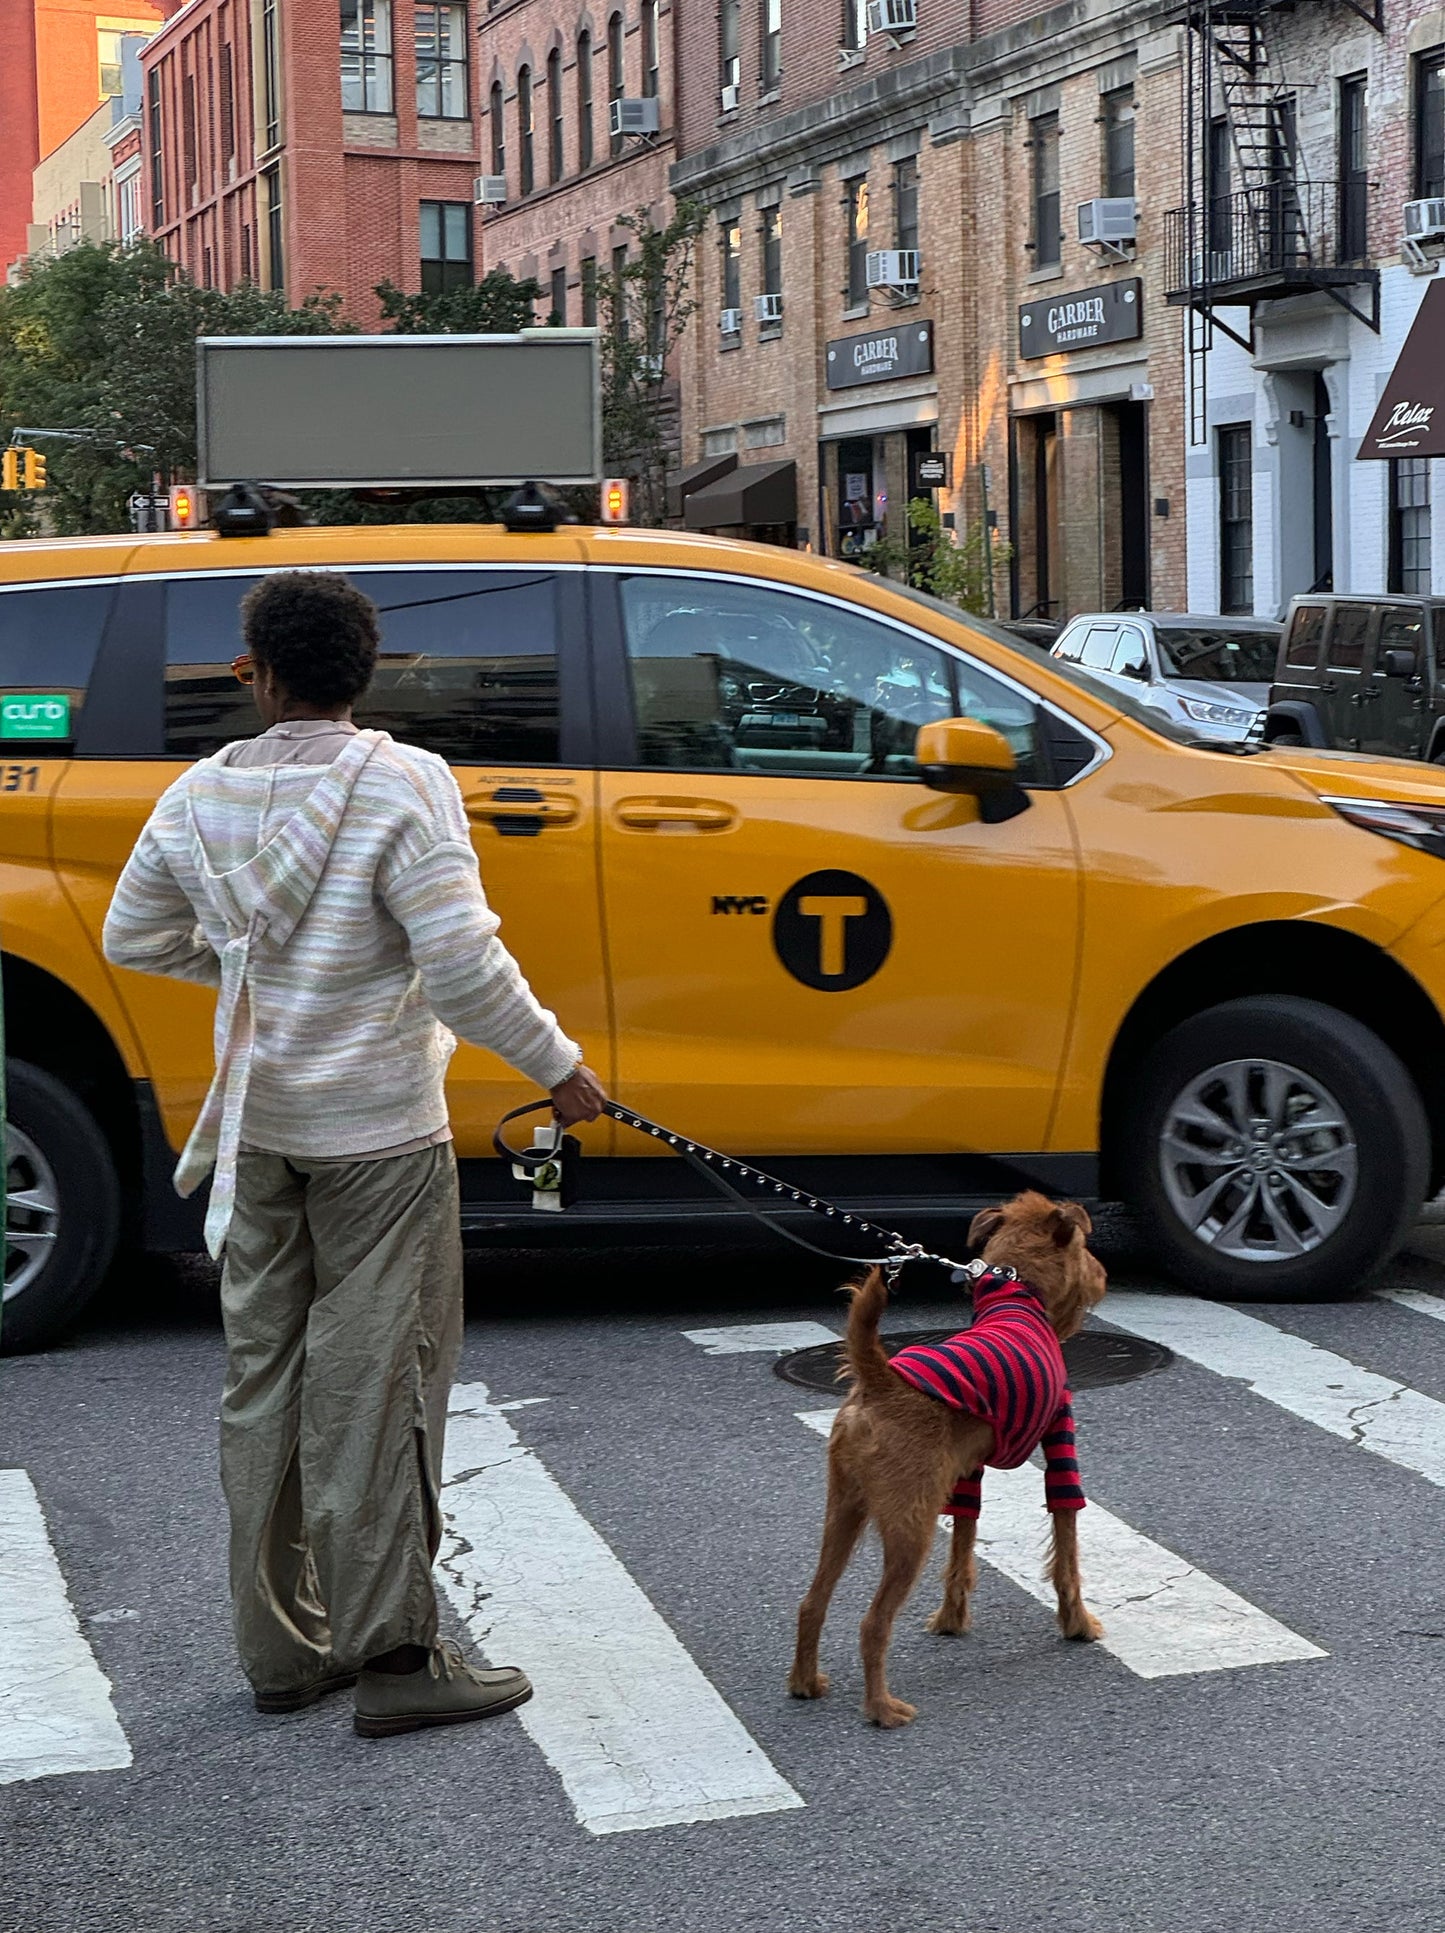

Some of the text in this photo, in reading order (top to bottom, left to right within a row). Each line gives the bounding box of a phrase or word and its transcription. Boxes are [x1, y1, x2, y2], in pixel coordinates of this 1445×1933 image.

[1047, 297, 1105, 333] GARBER
[1056, 325, 1098, 343] HARDWARE
[853, 337, 899, 367] GARBER
[1382, 401, 1434, 432] Relax
[2, 701, 65, 719] curb
[0, 765, 40, 792] 31
[711, 896, 867, 976] NYC T
